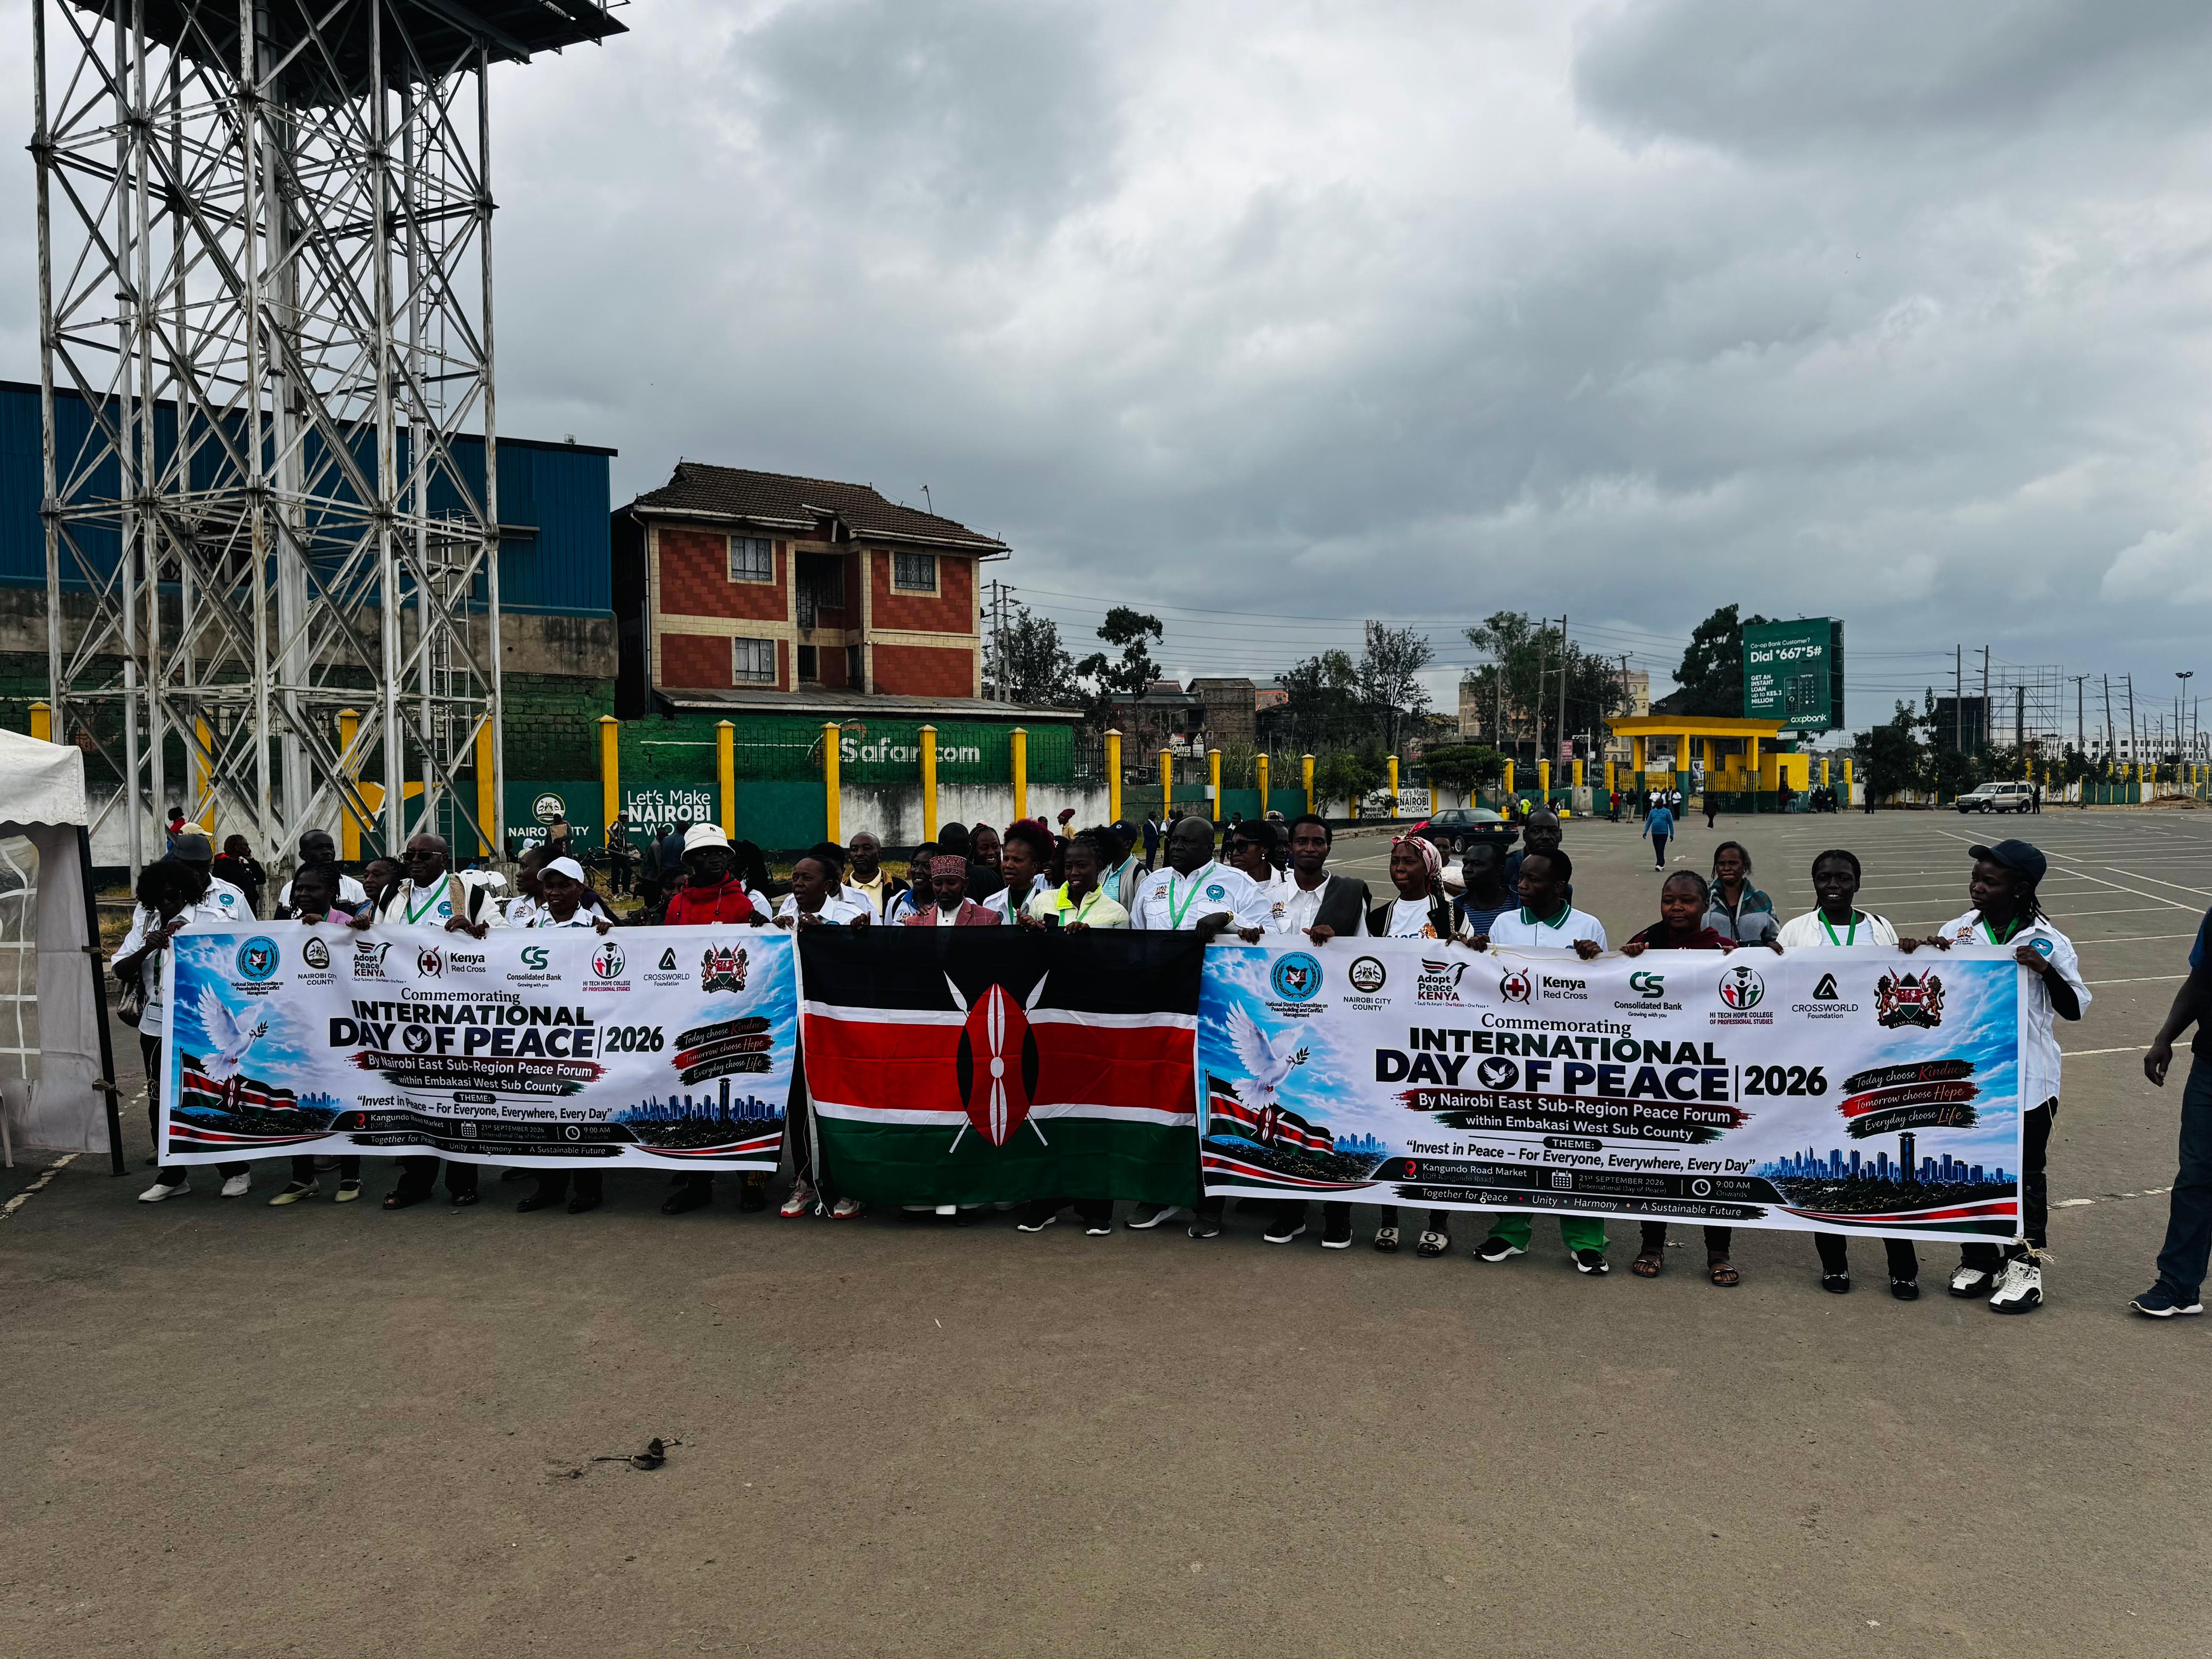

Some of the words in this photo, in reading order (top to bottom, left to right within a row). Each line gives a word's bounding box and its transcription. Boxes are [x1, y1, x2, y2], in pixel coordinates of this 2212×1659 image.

[1750, 649, 1773, 663] Dial
[839, 738, 981, 764] Safarcom
[628, 790, 664, 806] Let's
[669, 790, 710, 805] Make
[1400, 797, 1428, 806] NAIROBI
[629, 805, 711, 823] NAIROBI
[353, 954, 378, 963] Adopt
[355, 961, 380, 969] Peace
[450, 953, 485, 966] Kenya
[354, 969, 386, 977] KENYA
[451, 965, 466, 973] Red
[1417, 975, 1451, 985] Adopt
[1418, 983, 1453, 992] Peace
[1543, 976, 1586, 991] Kenya
[401, 987, 521, 1006] Commemorating
[1418, 991, 1460, 1001] KENYA
[1543, 990, 1561, 1000] Red
[1563, 991, 1588, 1001] Cross
[351, 1000, 594, 1027] INTERNATIONAL
[1614, 1001, 1662, 1011] Consolidated
[1663, 1002, 1682, 1011] Bank
[1792, 1003, 1858, 1013] CROSSWORLD
[1481, 1013, 1631, 1039] Commemorating
[330, 1018, 398, 1051] DAY
[464, 1028, 595, 1058] PEACE
[605, 1026, 664, 1053] 2026
[1410, 1027, 1726, 1065] INTERNATIONAL
[368, 1054, 380, 1069] By
[381, 1055, 415, 1070] Nairobi
[418, 1058, 443, 1070] East
[447, 1059, 514, 1076] Sub-Region
[518, 1063, 554, 1075] Peace
[556, 1064, 592, 1077] Forum
[1376, 1049, 1470, 1087] DAY
[1563, 1062, 1729, 1101] PEACE
[1745, 1066, 1828, 1096] 2026
[1855, 1076, 1884, 1088] Today
[1886, 1070, 1917, 1082] choose
[1918, 1062, 1966, 1081] Kindness
[398, 1076, 423, 1086] within
[425, 1075, 471, 1088] Embakasi
[474, 1078, 499, 1090] West
[501, 1079, 522, 1090] Sub
[524, 1081, 563, 1093] County
[459, 1093, 491, 1103] THEME:
[1854, 1095, 1900, 1110] Tomorrow
[1903, 1090, 1932, 1102] choose
[1933, 1084, 1965, 1102] Hope
[396, 1095, 405, 1107] in
[406, 1096, 427, 1112] Peace
[436, 1103, 452, 1114] For
[454, 1104, 499, 1118] Everyone,
[501, 1107, 558, 1120] Everywhere,
[560, 1108, 586, 1121] Every
[1419, 1093, 1436, 1109] By
[1440, 1094, 1494, 1108] Nairobi
[1498, 1097, 1532, 1111] East
[1537, 1099, 1629, 1118] Sub-Region
[1633, 1106, 1679, 1121] Peace
[1683, 1108, 1731, 1124] Forum
[1865, 1116, 1907, 1131] Everyday
[1908, 1111, 1937, 1123] choose
[1937, 1106, 1964, 1126] Life
[1466, 1116, 1502, 1127] within
[1506, 1116, 1569, 1132] Embakasi
[1573, 1121, 1608, 1134] West
[1612, 1123, 1639, 1136] Sub
[1643, 1126, 1694, 1142] County
[1552, 1138, 1595, 1150] THEME:
[1406, 1141, 1450, 1155] “Invest
[1453, 1143, 1464, 1155] in
[1468, 1142, 1504, 1159] Peace
[1519, 1148, 1540, 1162] For
[1543, 1151, 1605, 1168] Everyone,
[1608, 1154, 1685, 1172] Everywhere,
[1688, 1158, 1727, 1175] Every
[1724, 1158, 1755, 1176] Day”
[1423, 1163, 1468, 1174] Kangundo
[1470, 1166, 1493, 1175] Road
[1495, 1168, 1528, 1177] Market
[1595, 1176, 1644, 1185] SEPTEMBER
[1716, 1180, 1735, 1189] 9:00
[1736, 1181, 1750, 1189] AM
[1422, 1188, 1463, 1200] Together
[1465, 1191, 1478, 1200] for
[1480, 1192, 1508, 1202] Peace
[1532, 1195, 1558, 1207] Unity
[1573, 1198, 1618, 1211] Harmony
[1640, 1202, 1648, 1211] A
[1650, 1202, 1706, 1214] Sustainable
[1710, 1205, 1742, 1216] Future
